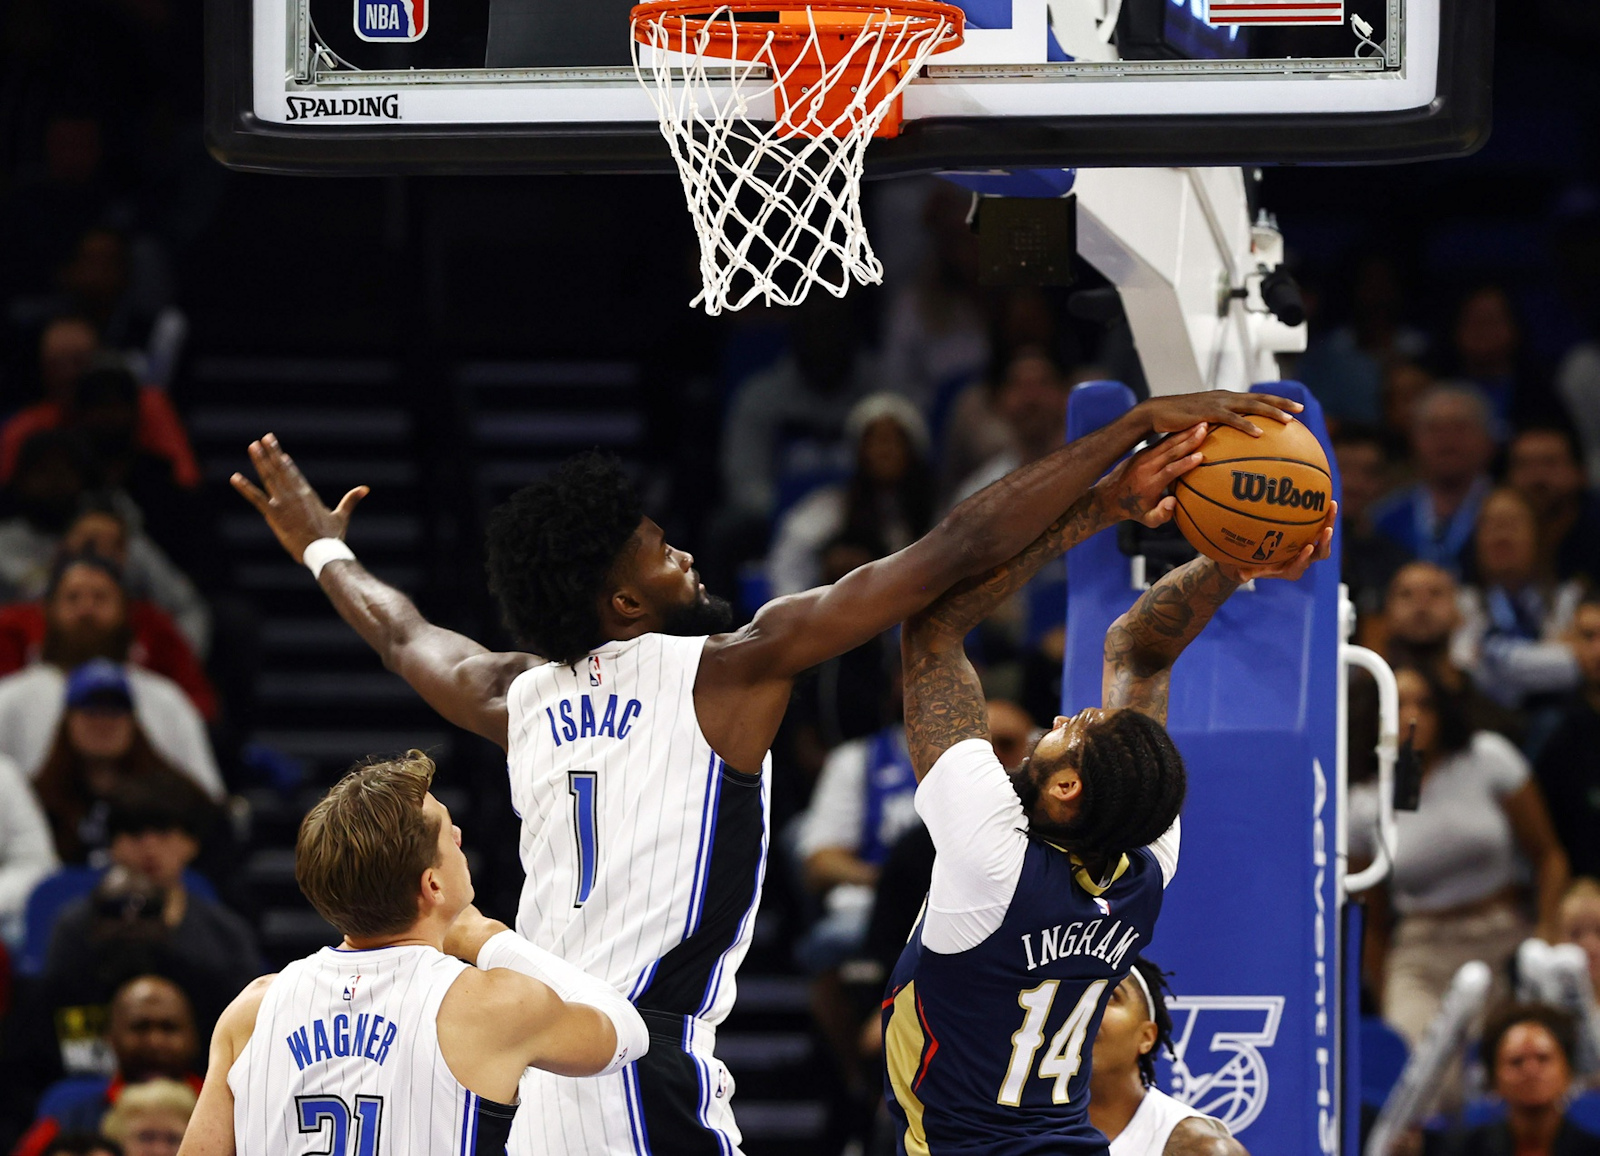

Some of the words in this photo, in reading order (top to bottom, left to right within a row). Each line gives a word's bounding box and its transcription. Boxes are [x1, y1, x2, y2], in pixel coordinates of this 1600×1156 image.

[365, 3, 400, 30] NBA
[286, 94, 399, 121] SPALDING
[1231, 470, 1326, 512] Wilson
[546, 694, 642, 747] ISAAC
[567, 770, 599, 909] 1
[1021, 919, 1140, 971] INGRAM
[286, 1013, 398, 1071] WAGNER
[996, 979, 1109, 1107] 14
